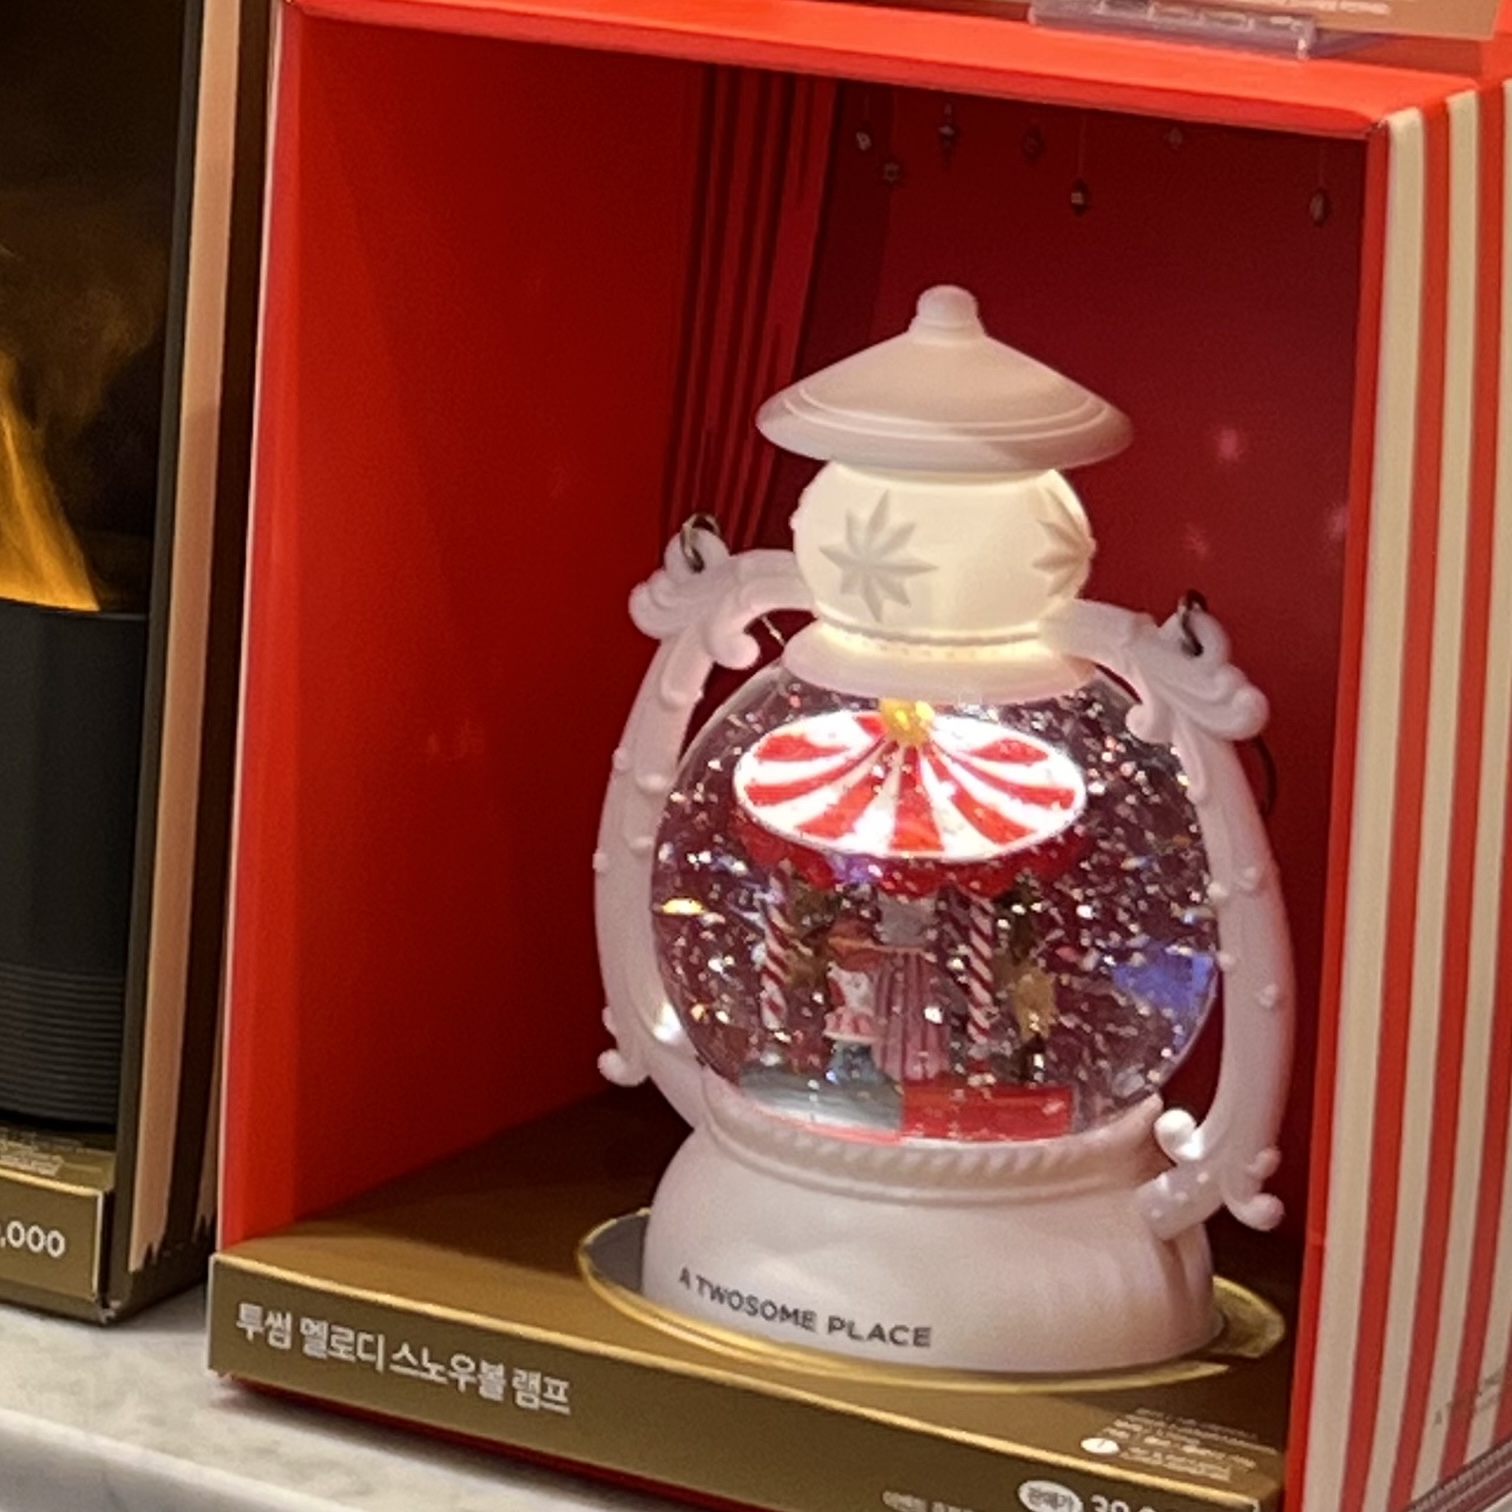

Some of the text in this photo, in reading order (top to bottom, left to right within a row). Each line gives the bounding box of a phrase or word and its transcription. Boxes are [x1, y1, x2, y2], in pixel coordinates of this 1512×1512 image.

[678, 1267, 933, 1348] A TWOSOME PLACE
[236, 1302, 571, 1416] 투썸 멜로디 스노우볼 램프
